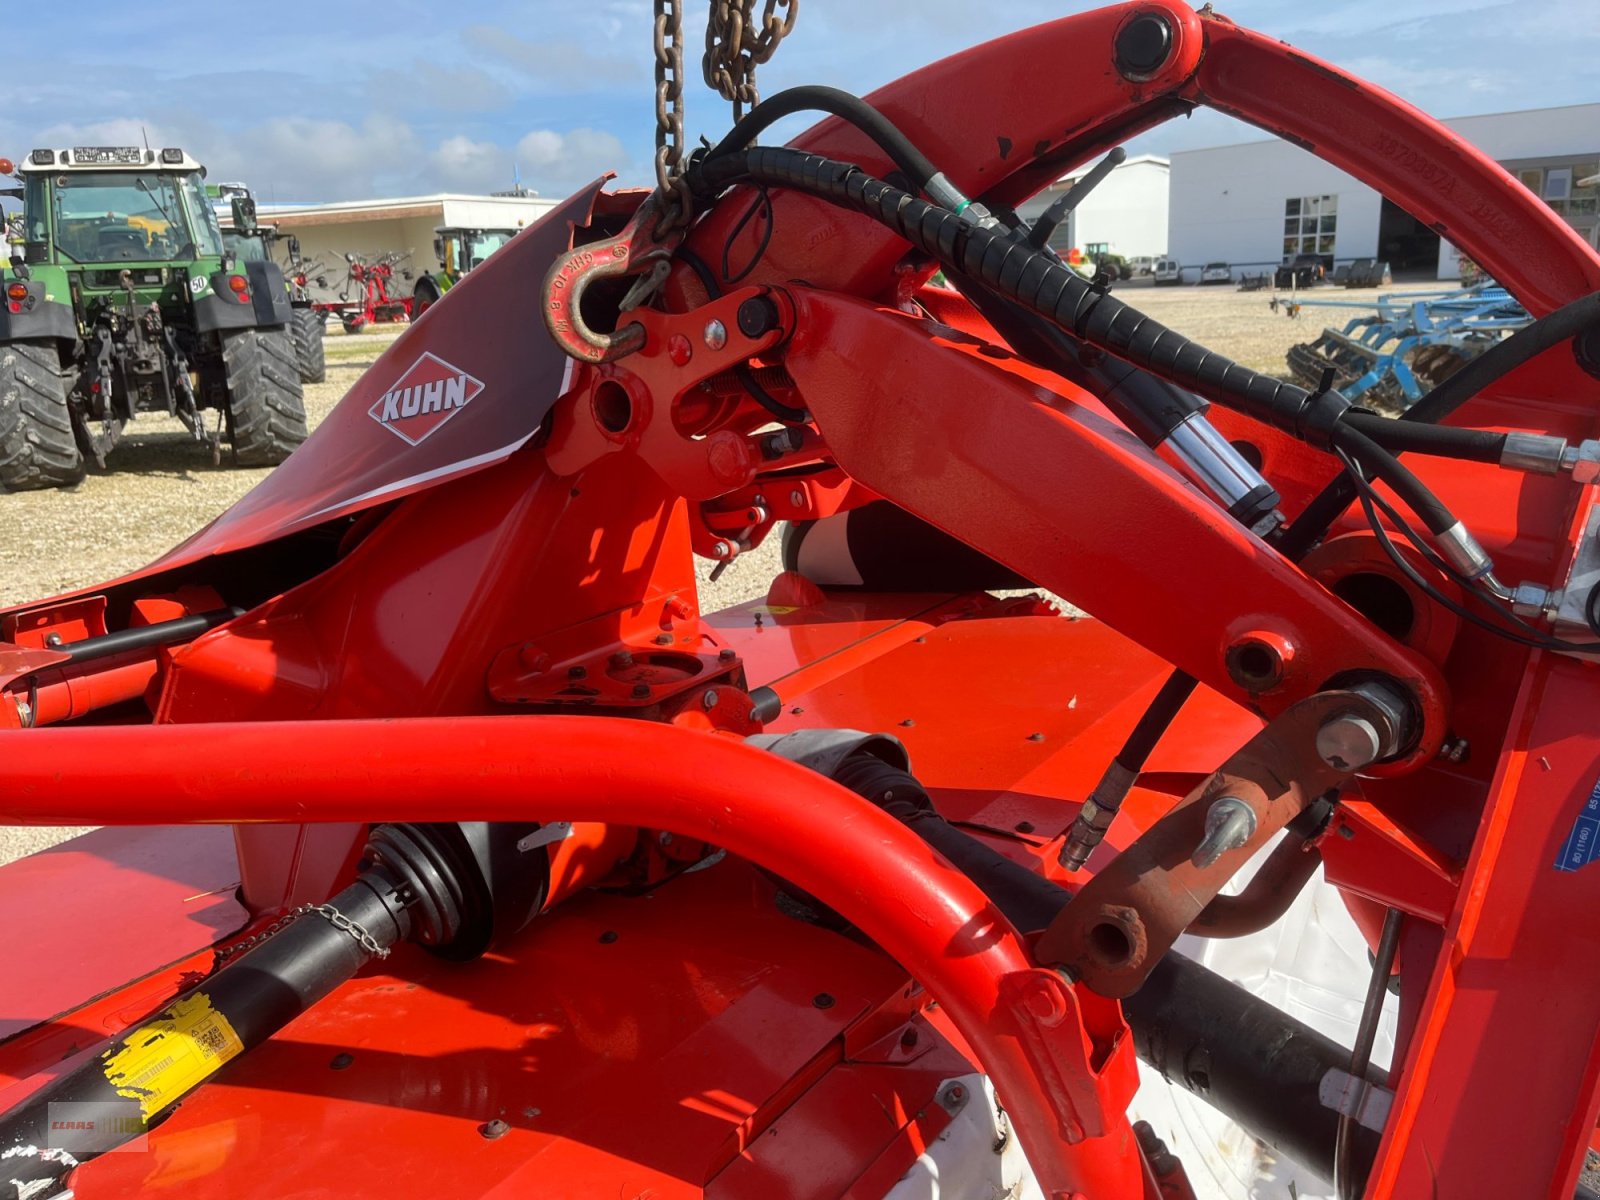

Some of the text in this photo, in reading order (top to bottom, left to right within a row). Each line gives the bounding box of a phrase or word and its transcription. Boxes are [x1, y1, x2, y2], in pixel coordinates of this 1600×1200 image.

[192, 276, 205, 291] 50
[381, 374, 467, 423] KUHN
[1588, 799, 1599, 810] 85
[1572, 827, 1591, 864] 80 (1160)
